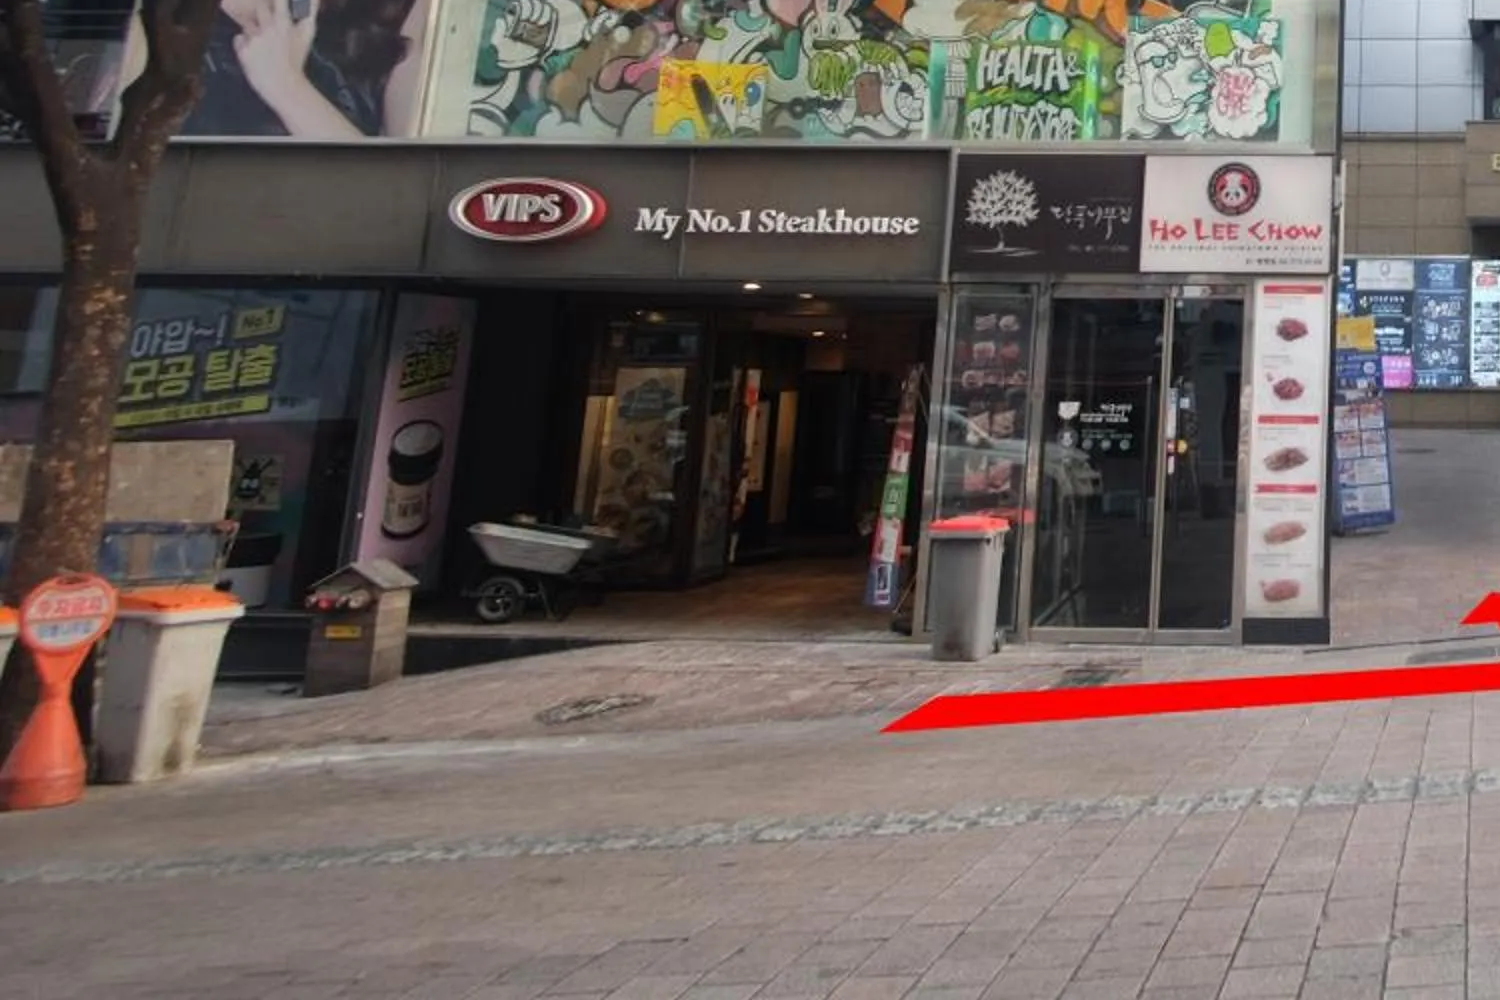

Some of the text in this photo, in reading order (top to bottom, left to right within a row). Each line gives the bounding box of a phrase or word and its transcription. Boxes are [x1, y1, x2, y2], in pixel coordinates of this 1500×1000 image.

[482, 192, 562, 223] VIPS
[634, 208, 921, 240] My No.1 Steakhouse
[1193, 217, 1240, 242] LEE
[122, 343, 278, 400] 모공 탈출
